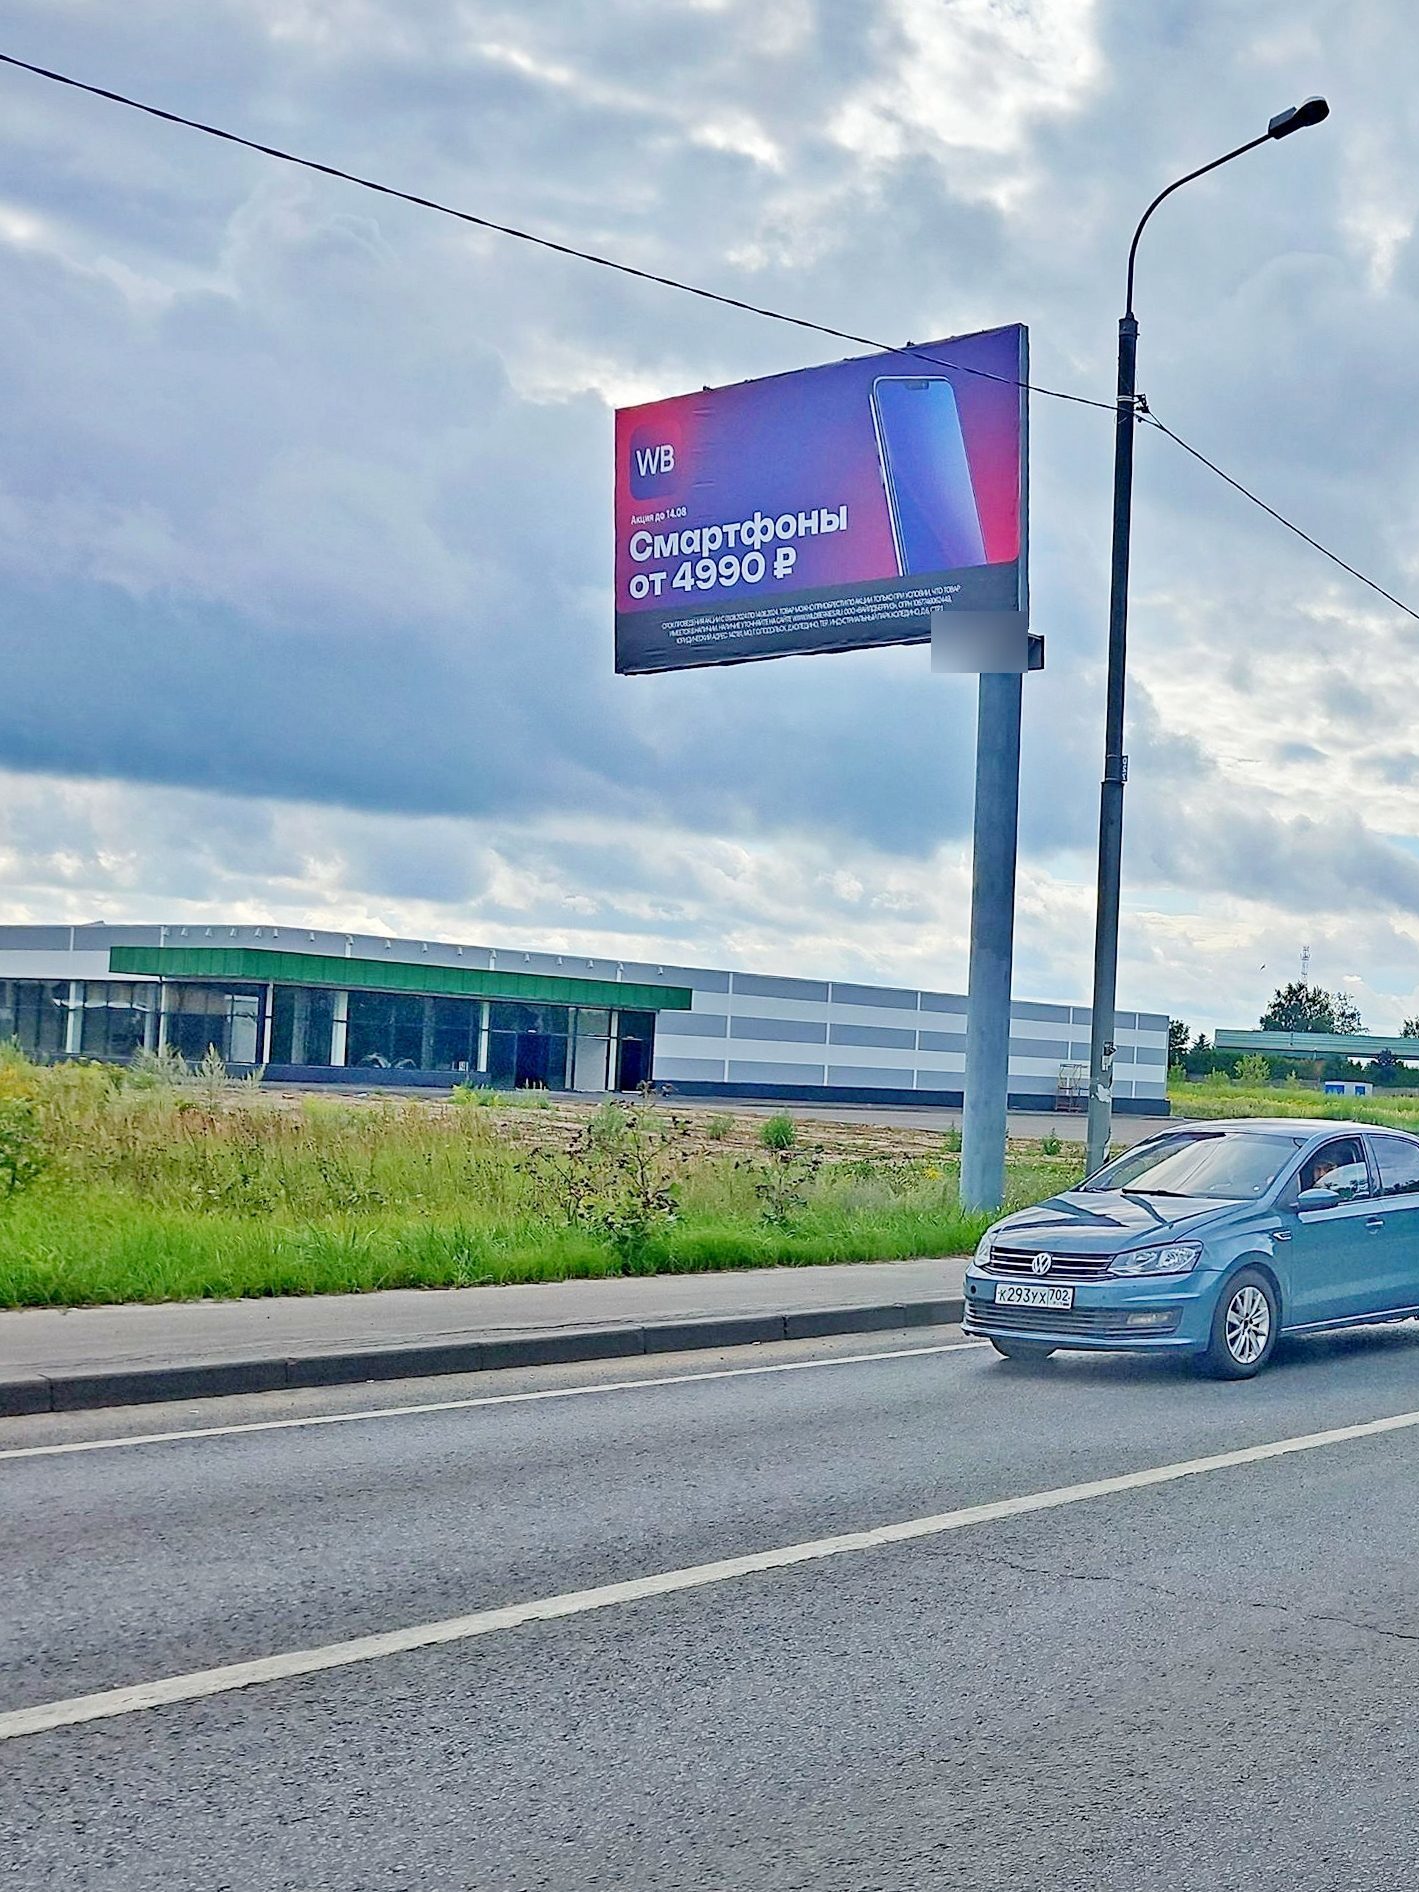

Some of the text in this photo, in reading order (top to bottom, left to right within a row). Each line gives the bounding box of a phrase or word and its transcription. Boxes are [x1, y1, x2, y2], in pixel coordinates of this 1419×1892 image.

[636, 444, 675, 476] WB
[631, 506, 687, 525] Акция до 14.08
[629, 505, 848, 562] Смартфоны
[629, 571, 667, 599] от
[672, 551, 766, 592] 4990
[1049, 1288, 1069, 1301] 702
